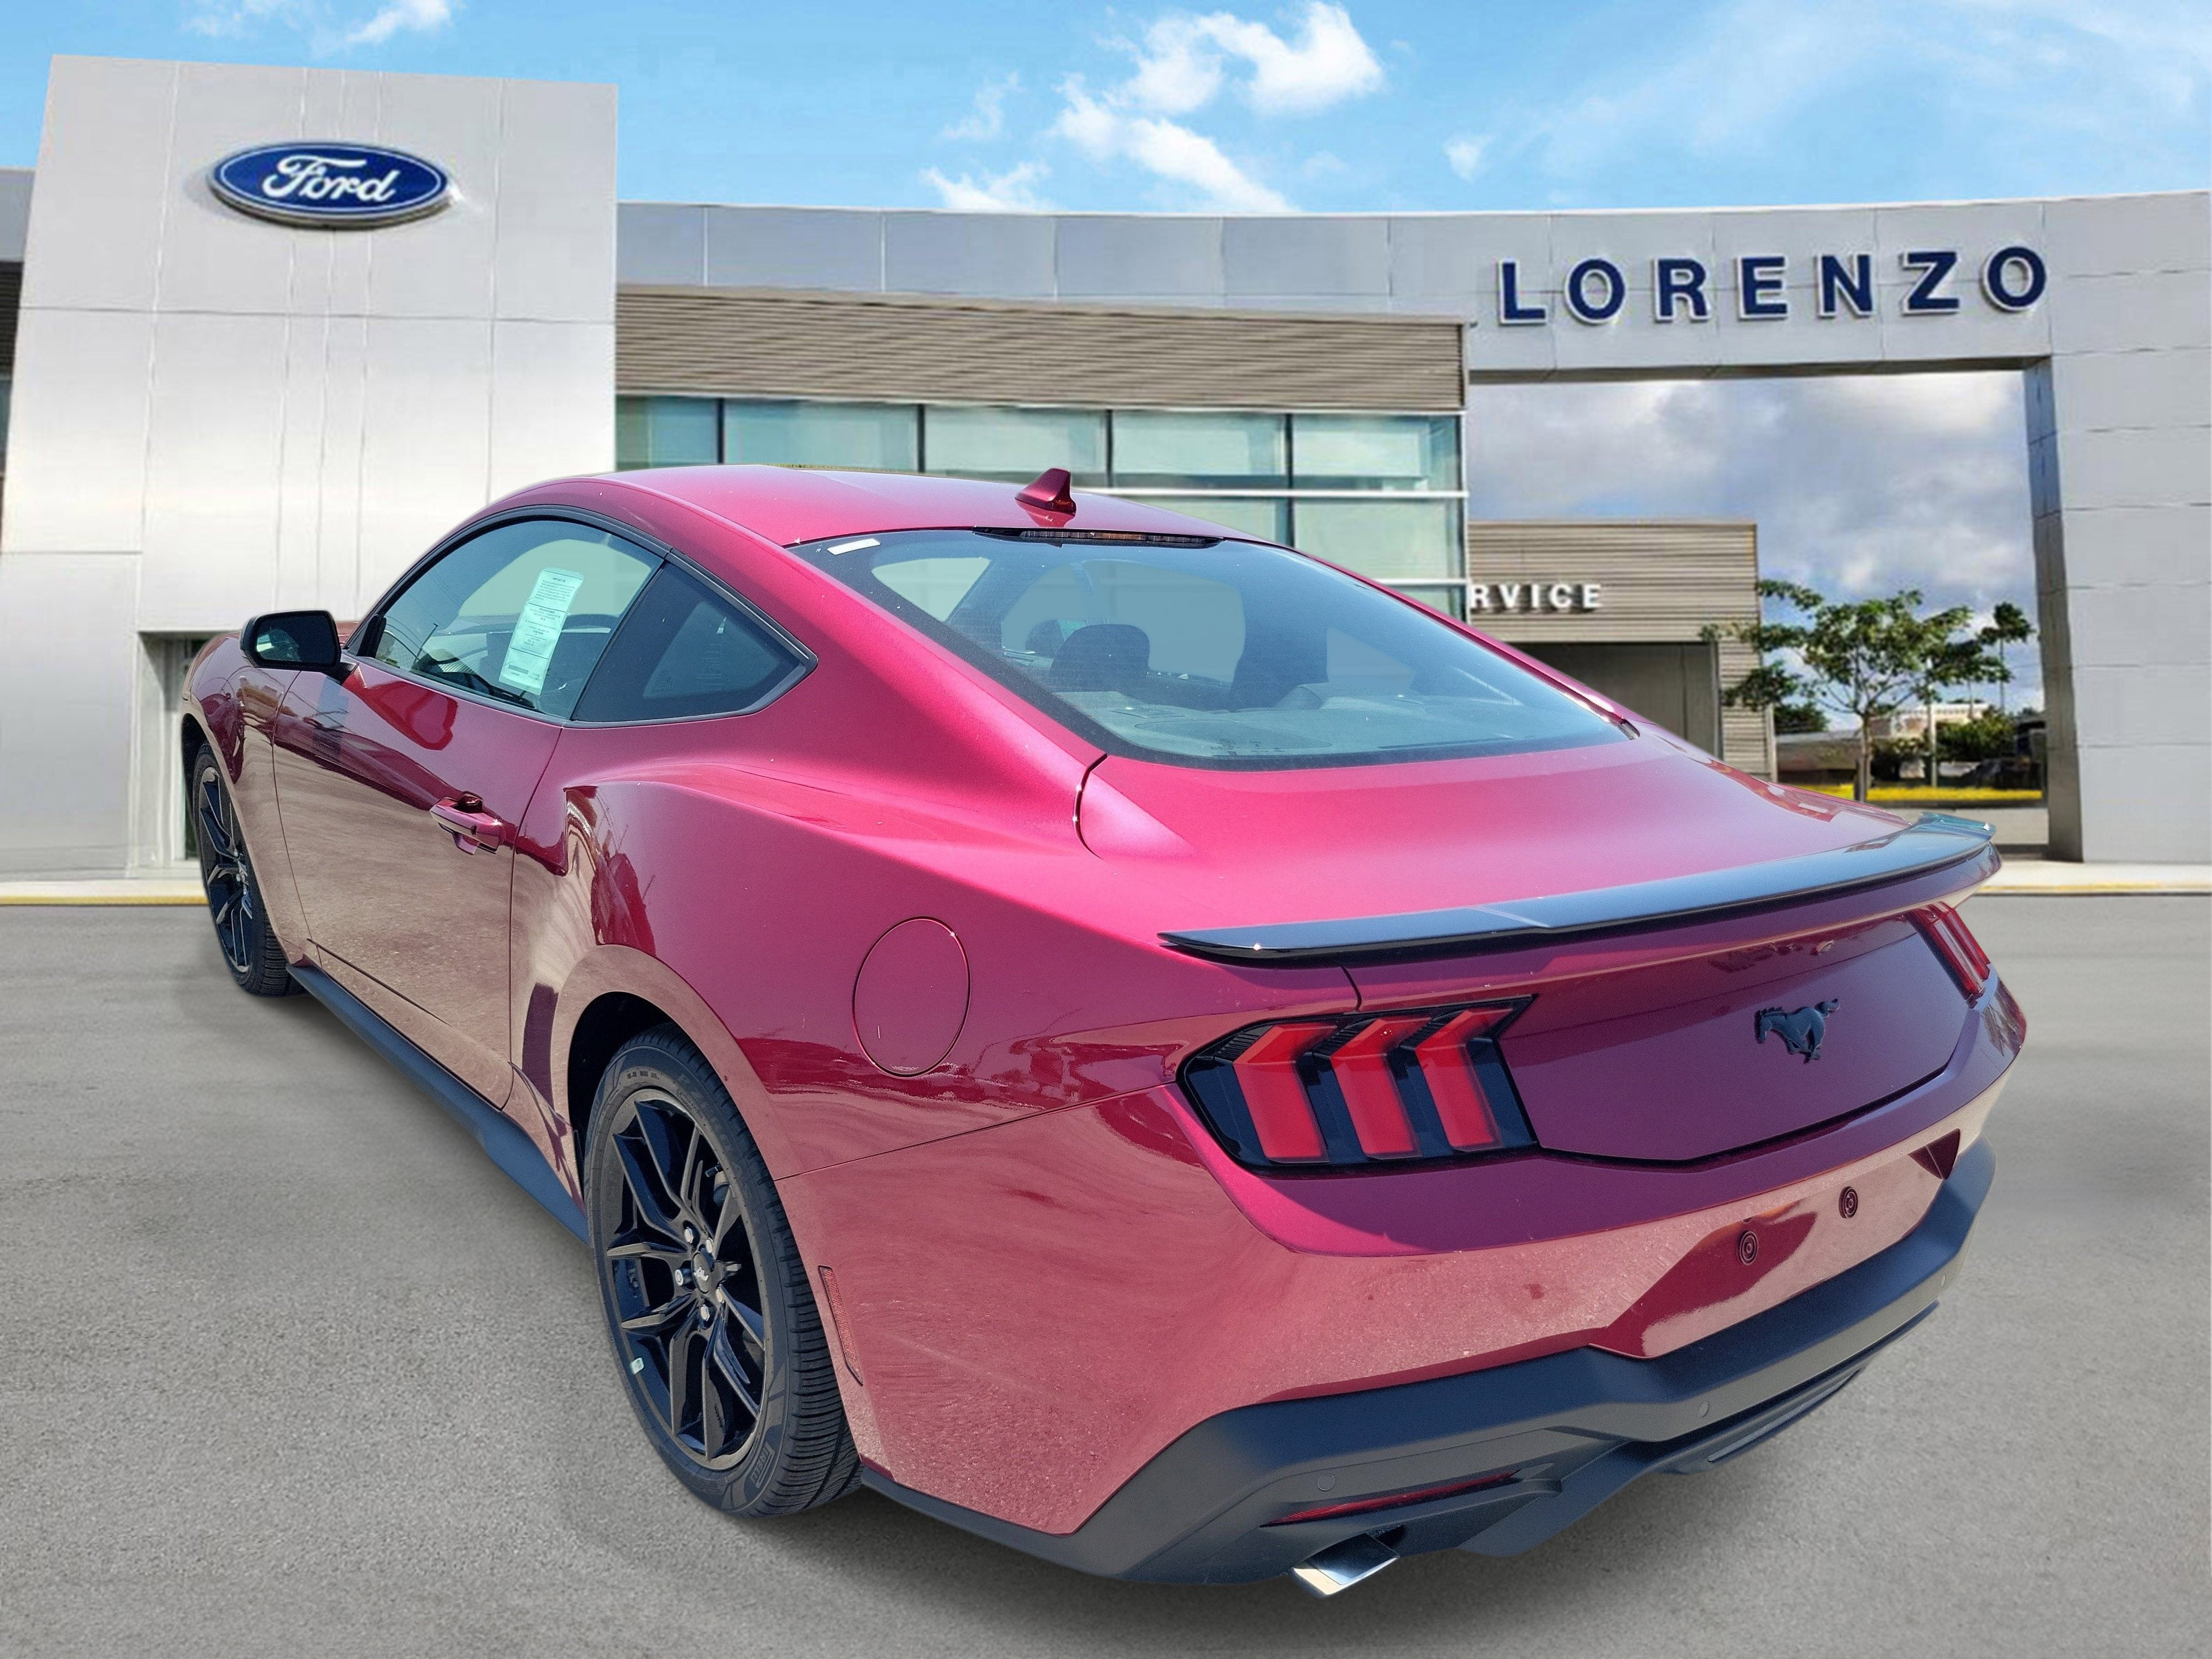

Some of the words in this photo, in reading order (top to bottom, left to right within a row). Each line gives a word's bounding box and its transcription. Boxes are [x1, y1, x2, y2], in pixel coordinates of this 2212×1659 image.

[263, 154, 401, 202] Ford
[1498, 245, 2047, 324] LORENZO
[1470, 584, 1602, 609] RVICE
